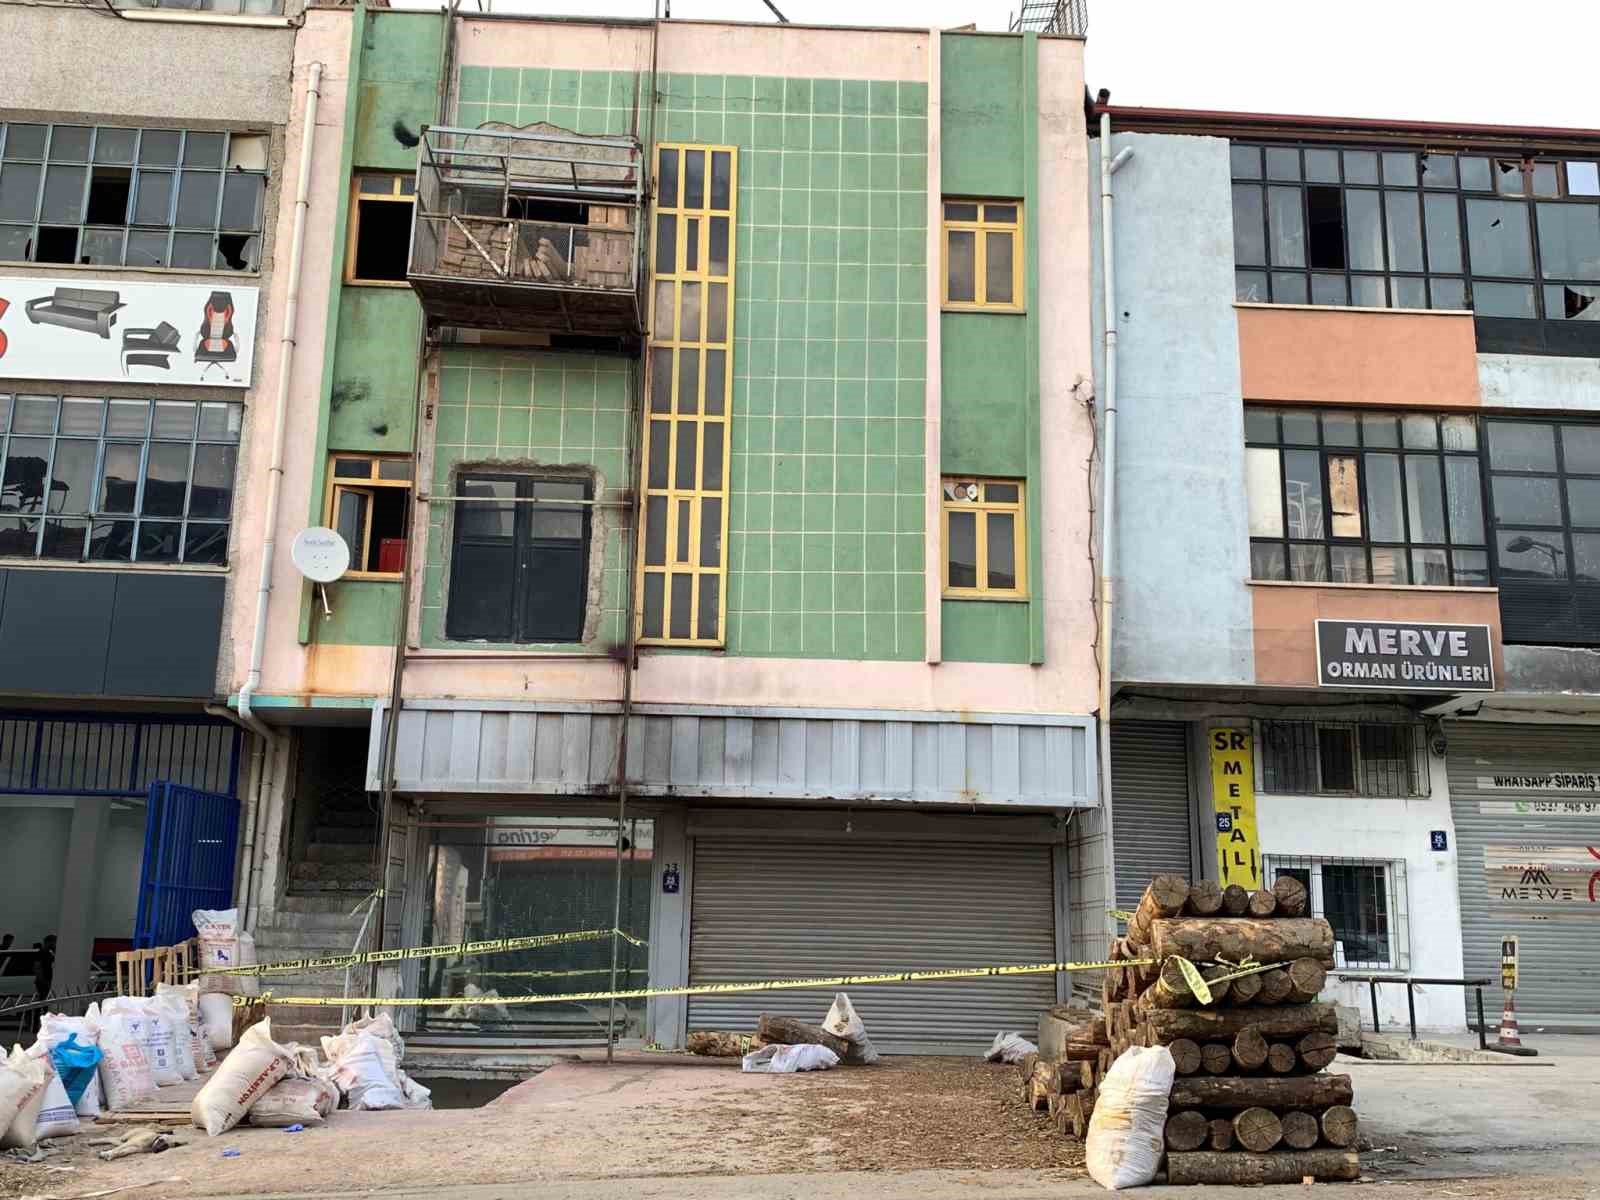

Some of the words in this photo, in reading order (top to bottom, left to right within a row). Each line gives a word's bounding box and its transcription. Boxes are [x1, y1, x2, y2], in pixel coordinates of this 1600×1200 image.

[1344, 627, 1469, 657] MERVE
[1327, 661, 1396, 680] ORMAN
[1400, 661, 1489, 682] ÜRÜNLERİ
[1214, 732, 1247, 750] SR
[1493, 776, 1551, 788] WHATSAPP
[1218, 817, 1230, 828] 25
[1223, 761, 1246, 866] METAL
